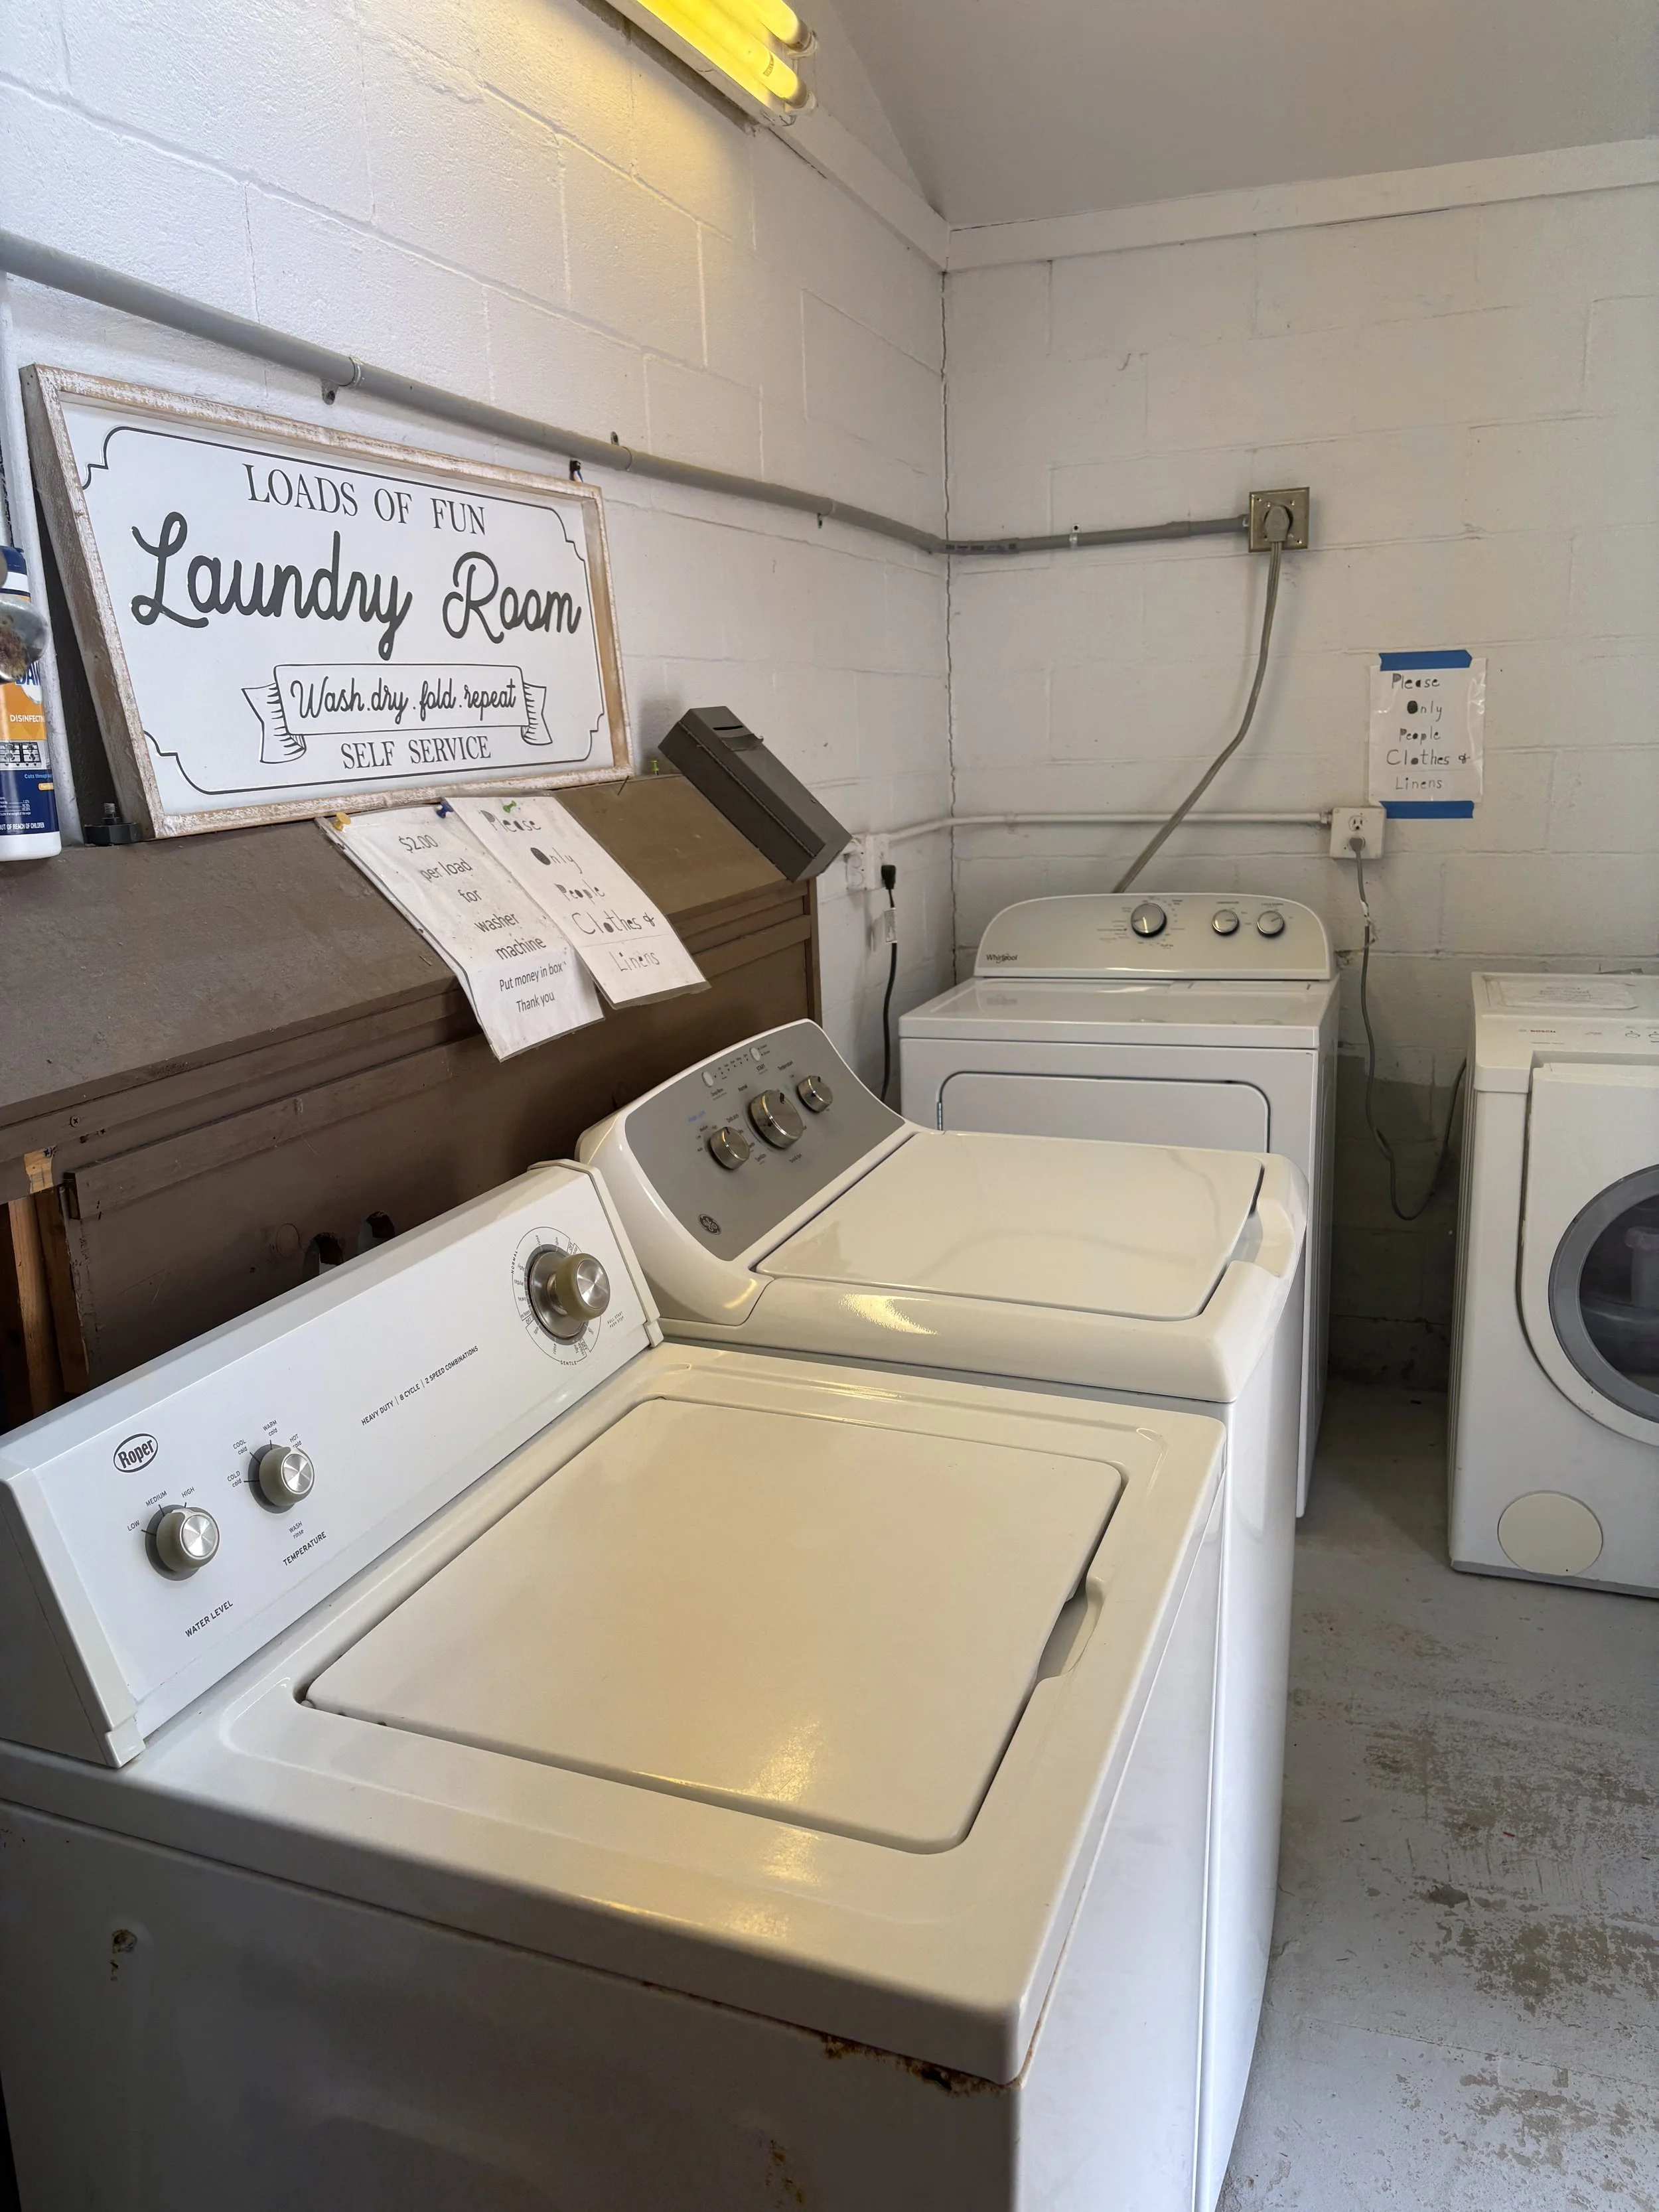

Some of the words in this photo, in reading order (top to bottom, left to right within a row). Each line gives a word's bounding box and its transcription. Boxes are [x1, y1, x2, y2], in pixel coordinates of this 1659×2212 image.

[242, 463, 358, 517] LOADS
[374, 487, 413, 525] OF
[430, 497, 486, 536] FUN
[130, 512, 413, 661] Laundry
[443, 551, 581, 644] Room
[1392, 672, 1440, 690] Please
[1407, 700, 1443, 722] Only
[1399, 726, 1441, 745] People
[340, 740, 395, 769] SELF
[408, 735, 491, 764] SERVICE
[1386, 749, 1450, 765] Clothes
[1458, 753, 1471, 764] &
[1395, 775, 1443, 790] Linens
[480, 810, 541, 832] Please
[398, 834, 439, 853] $2.00
[419, 865, 443, 883] per
[438, 857, 474, 876] load
[530, 847, 583, 874] Only
[458, 889, 482, 903] for
[553, 879, 605, 905] People
[474, 912, 520, 933] washer
[571, 909, 642, 934] Clothes
[642, 912, 656, 927] &
[494, 938, 547, 960] machine
[985, 953, 1017, 964] Whirlpool
[609, 951, 660, 972] Linens
[499, 977, 514, 992] Put
[514, 970, 539, 987] money
[540, 966, 547, 978] in
[548, 962, 563, 976] box
[516, 994, 540, 1013] Thank
[540, 992, 555, 1007] you
[614, 1311, 623, 1321] START
[361, 1410, 380, 1426] HEAVY
[379, 1400, 394, 1414] DUTY
[404, 1383, 420, 1398] CYCLE
[429, 1367, 445, 1382] SPEED
[445, 1345, 478, 1371] COMBINATIONS
[262, 1420, 277, 1432] WARM
[268, 1428, 278, 1436] cold
[233, 1439, 247, 1449] COOL
[289, 1434, 299, 1443] HOT
[117, 1439, 155, 1469] Roper
[238, 1446, 248, 1455] cold
[227, 1470, 241, 1482] COLD
[232, 1478, 242, 1488] cold
[145, 1490, 168, 1507] MEDIUM
[181, 1486, 195, 1498] HIGH
[127, 1519, 141, 1531] LOW
[289, 1520, 303, 1533] WASH
[293, 1528, 305, 1539] rinse
[282, 1530, 327, 1566] TEMPERATURE
[184, 1616, 210, 1637] WATER
[210, 1599, 234, 1619] LEVEL
